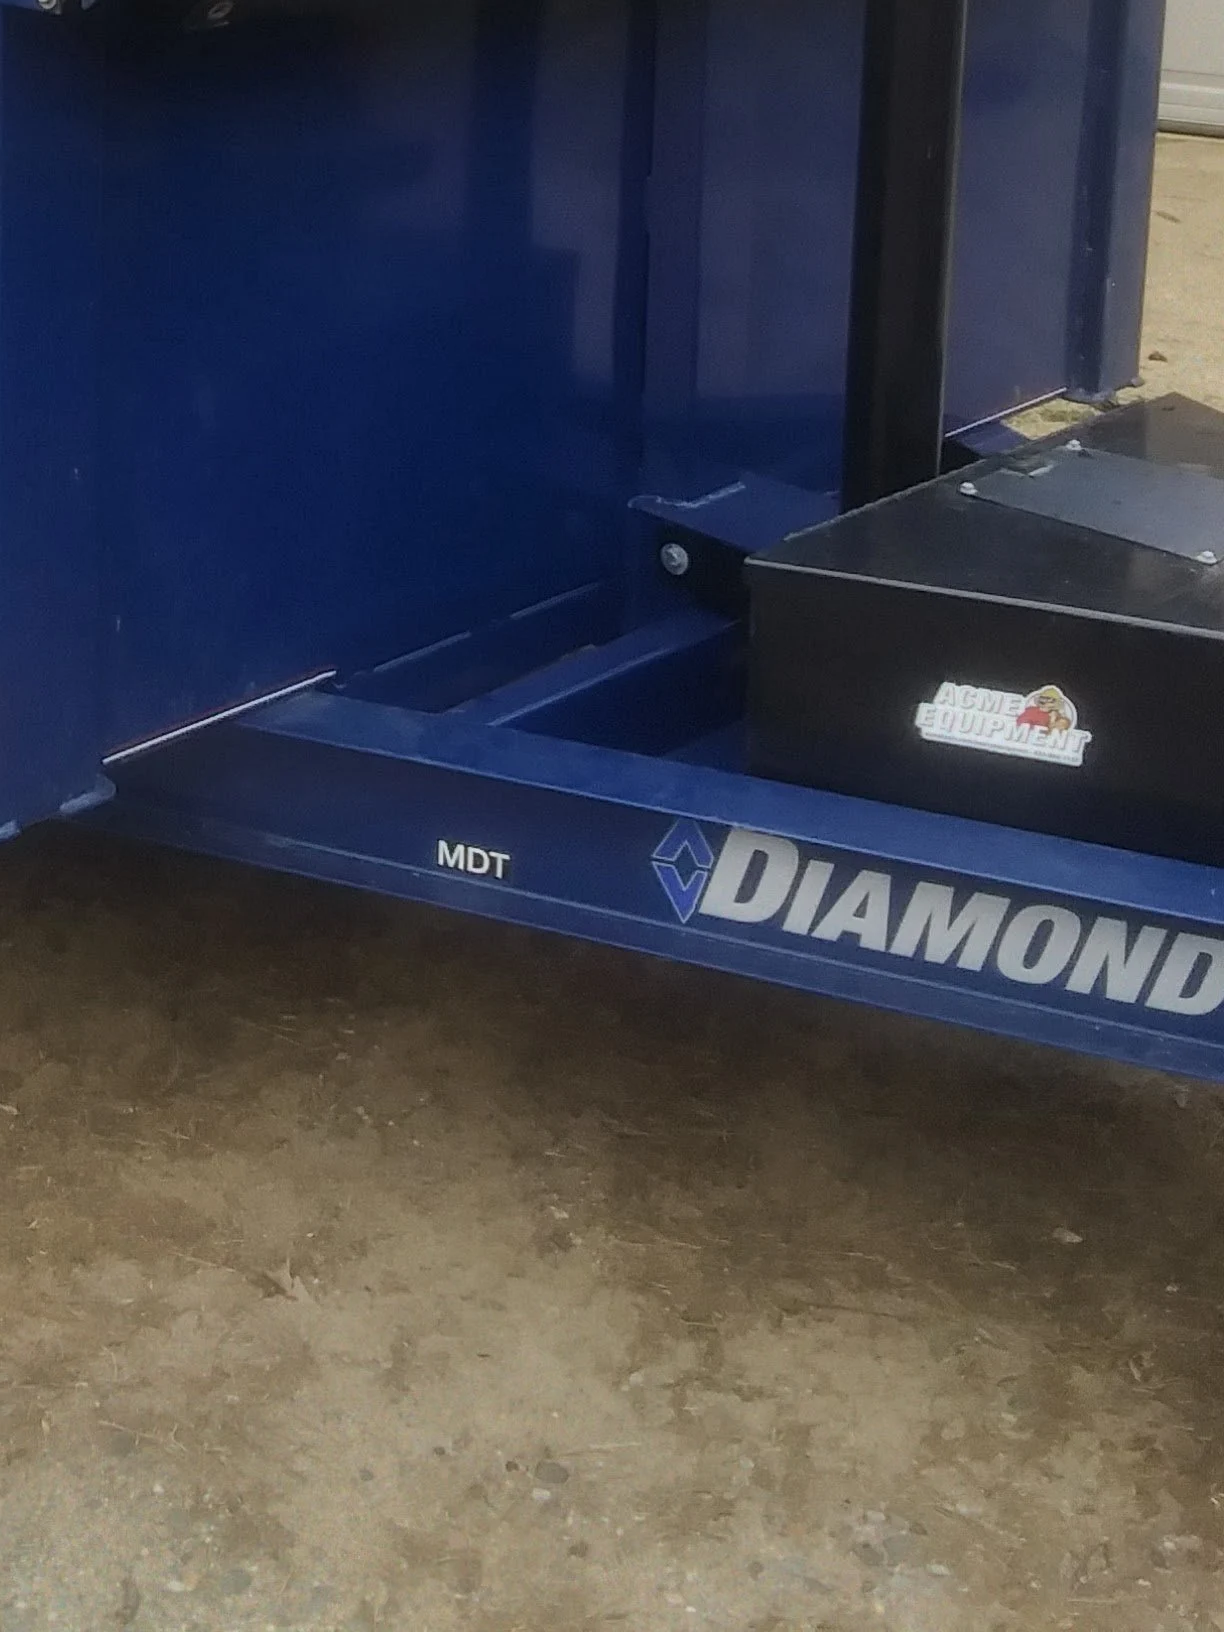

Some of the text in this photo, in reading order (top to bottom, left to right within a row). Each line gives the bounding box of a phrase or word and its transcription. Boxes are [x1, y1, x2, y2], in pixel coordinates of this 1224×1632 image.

[937, 685, 1024, 716] ACME
[917, 704, 1089, 753] EQUIPMENT
[437, 839, 511, 879] MDT
[698, 825, 1224, 1016] DIAMOND
